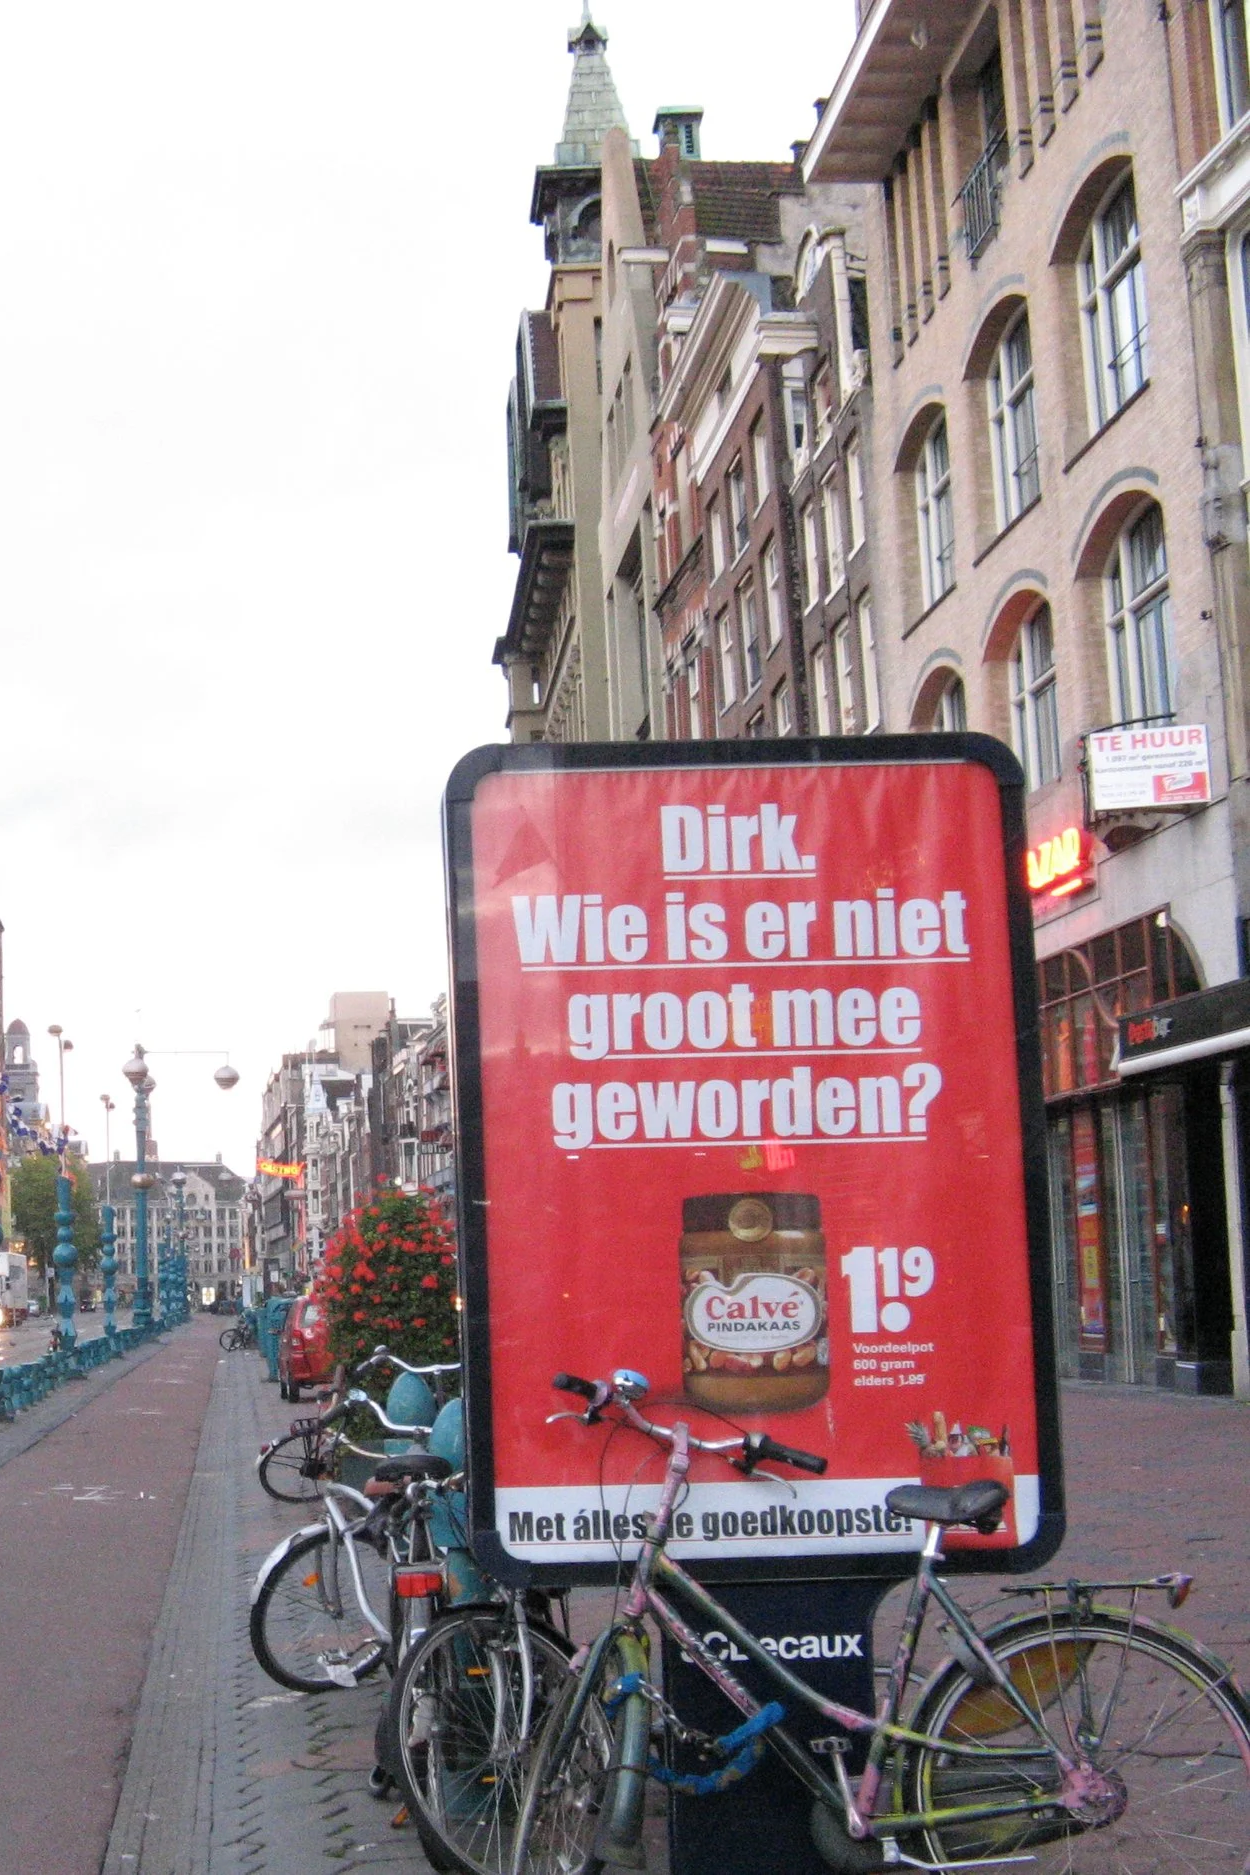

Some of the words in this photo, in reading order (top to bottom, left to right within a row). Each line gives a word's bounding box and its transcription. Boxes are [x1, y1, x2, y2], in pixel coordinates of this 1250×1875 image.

[1093, 735, 1123, 752] TE
[1130, 729, 1203, 749] HUUR
[660, 802, 816, 873] Dirk.
[511, 893, 648, 963] Wie
[664, 891, 728, 961] is
[743, 897, 817, 959] er
[832, 887, 970, 957] niet
[567, 983, 757, 1061] groot
[770, 986, 922, 1049] mee
[551, 1062, 943, 1150] geworden?
[705, 1291, 800, 1321] Calvé
[707, 1321, 801, 1332] PINDAKAAS
[852, 1341, 934, 1355] Voordeelpot
[853, 1359, 877, 1370] 600
[880, 1360, 915, 1372] gram
[854, 1375, 895, 1386] elders
[508, 1511, 566, 1542] Met
[572, 1508, 648, 1541] álles
